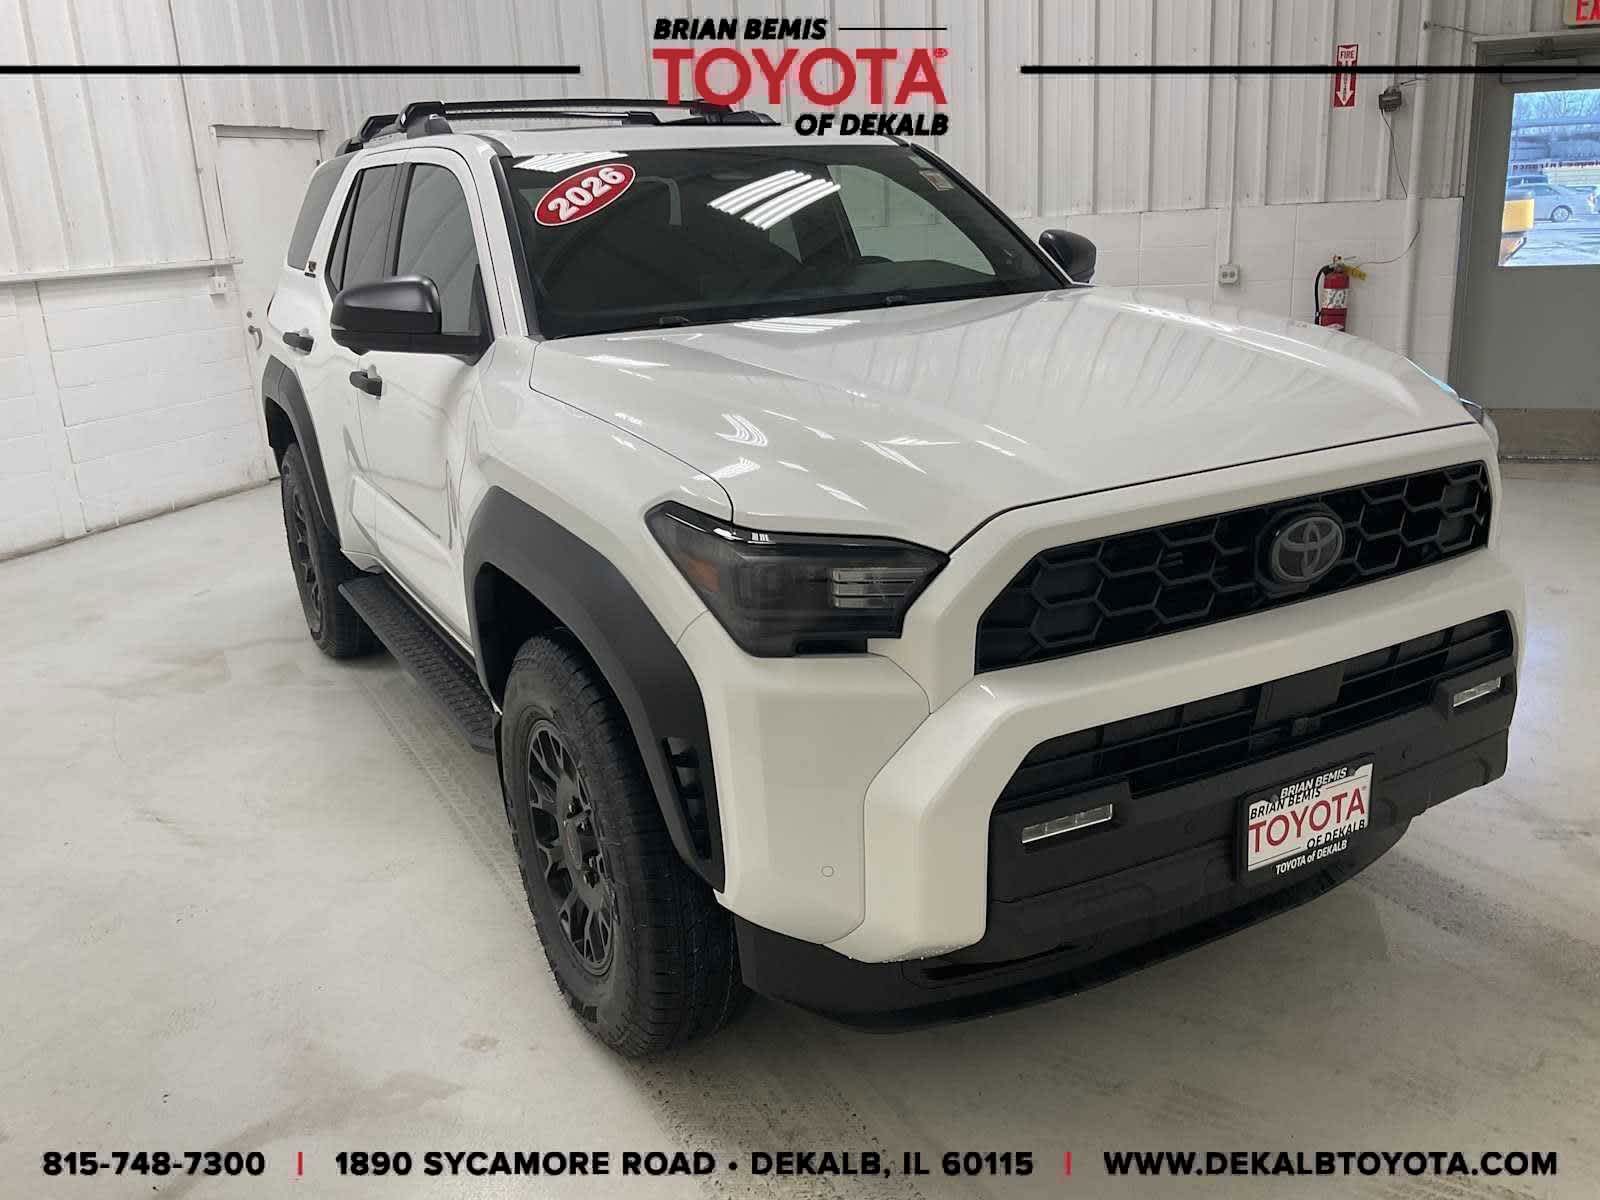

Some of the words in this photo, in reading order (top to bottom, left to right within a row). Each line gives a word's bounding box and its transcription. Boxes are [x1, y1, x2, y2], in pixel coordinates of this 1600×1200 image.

[1340, 50, 1355, 59] FIRE
[547, 167, 625, 221] 2026
[1280, 778, 1314, 799] BRIAN
[1315, 767, 1348, 788] BEMIS
[1249, 788, 1365, 852] TOYOTA
[1250, 798, 1285, 820] BRIAN
[1288, 787, 1322, 807] BEMIS
[1307, 835, 1323, 849] OF
[1324, 819, 1365, 843] DEKALB
[1275, 855, 1306, 875] TOYOTA
[1307, 852, 1316, 863] of
[1316, 839, 1348, 860] DEKALB
